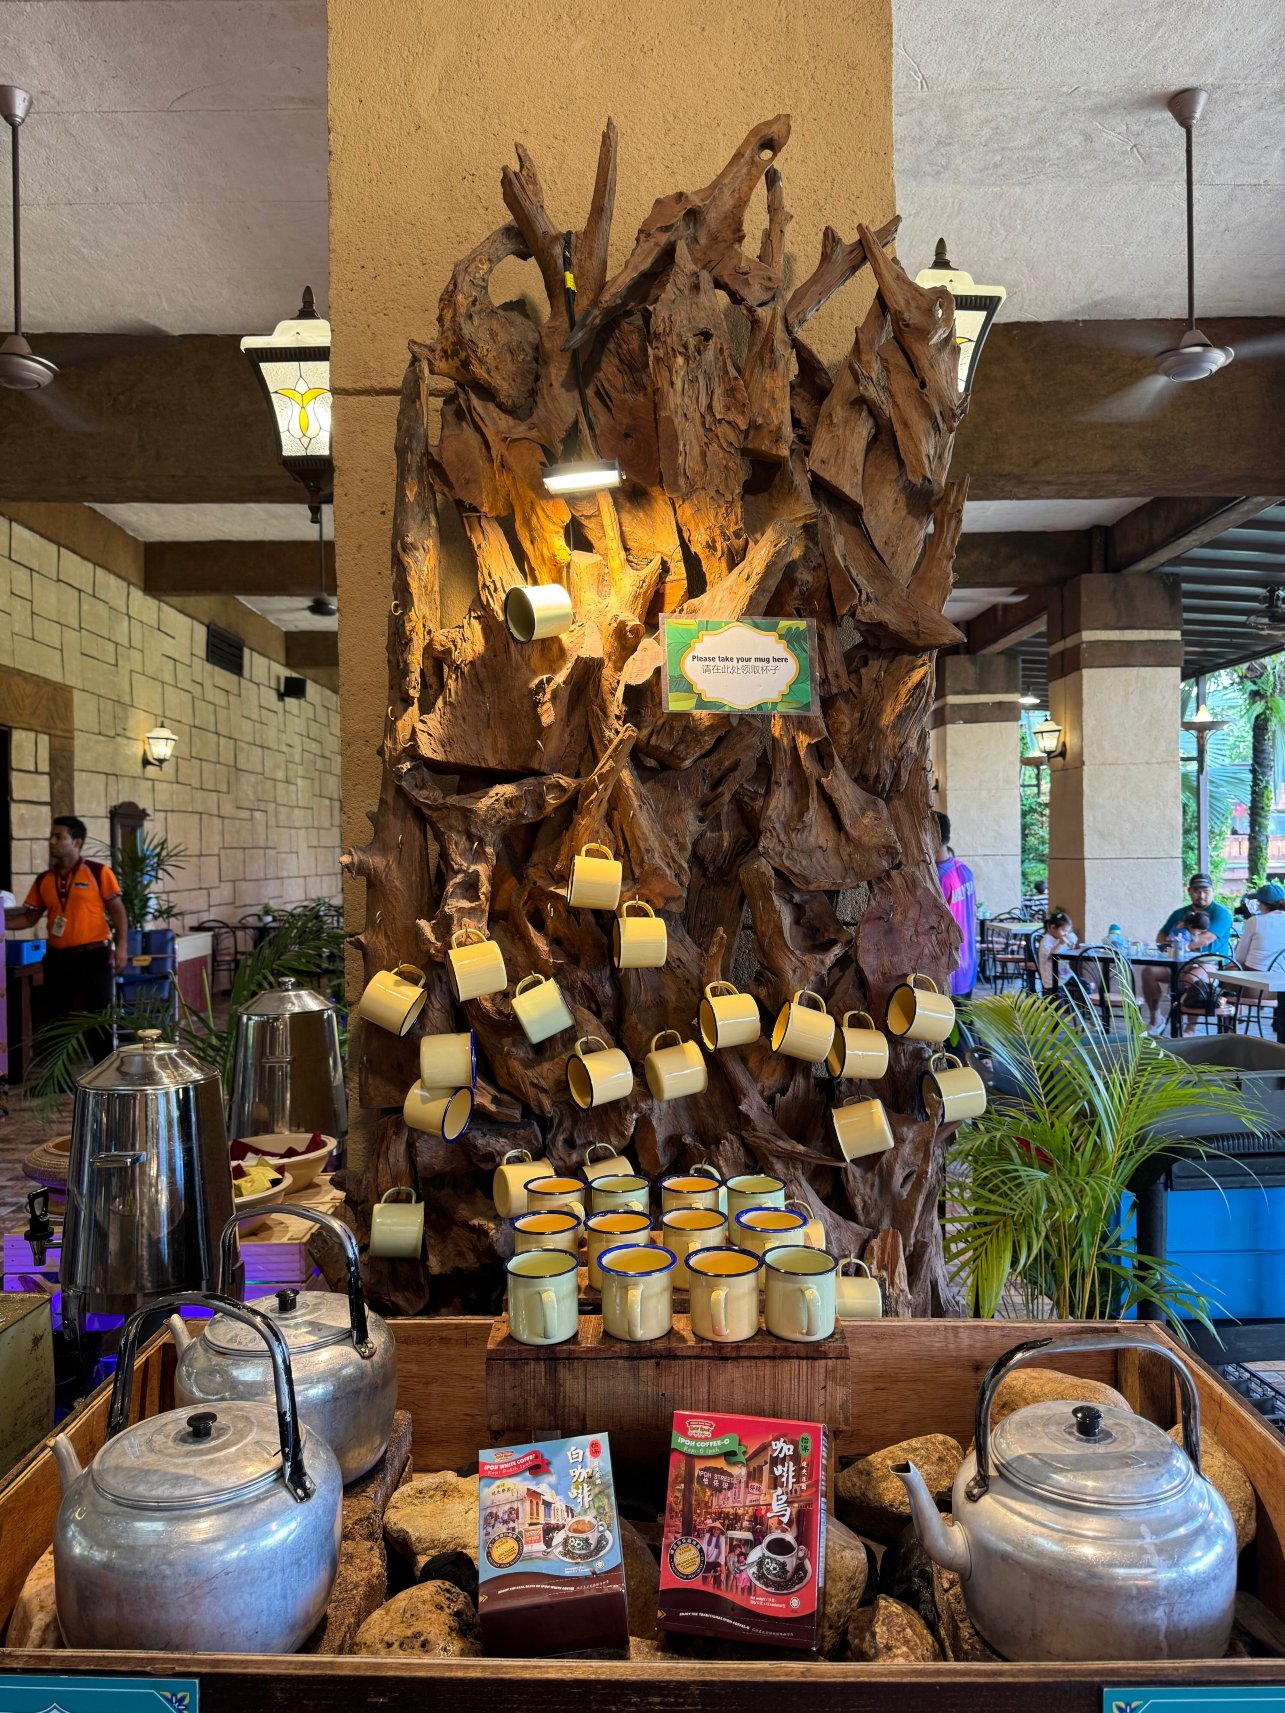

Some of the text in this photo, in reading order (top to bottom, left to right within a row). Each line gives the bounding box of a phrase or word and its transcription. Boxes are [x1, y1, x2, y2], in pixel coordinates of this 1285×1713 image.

[718, 655, 734, 663] take
[735, 656, 752, 664] your
[754, 656, 771, 664] mug
[702, 664, 780, 675] 请在此处领取杯子
[678, 1437, 730, 1447] IPOH COFFEE-O
[499, 1461, 516, 1470] WHITE
[566, 1446, 593, 1508] 白咖啡
[698, 1470, 712, 1479] IPOH
